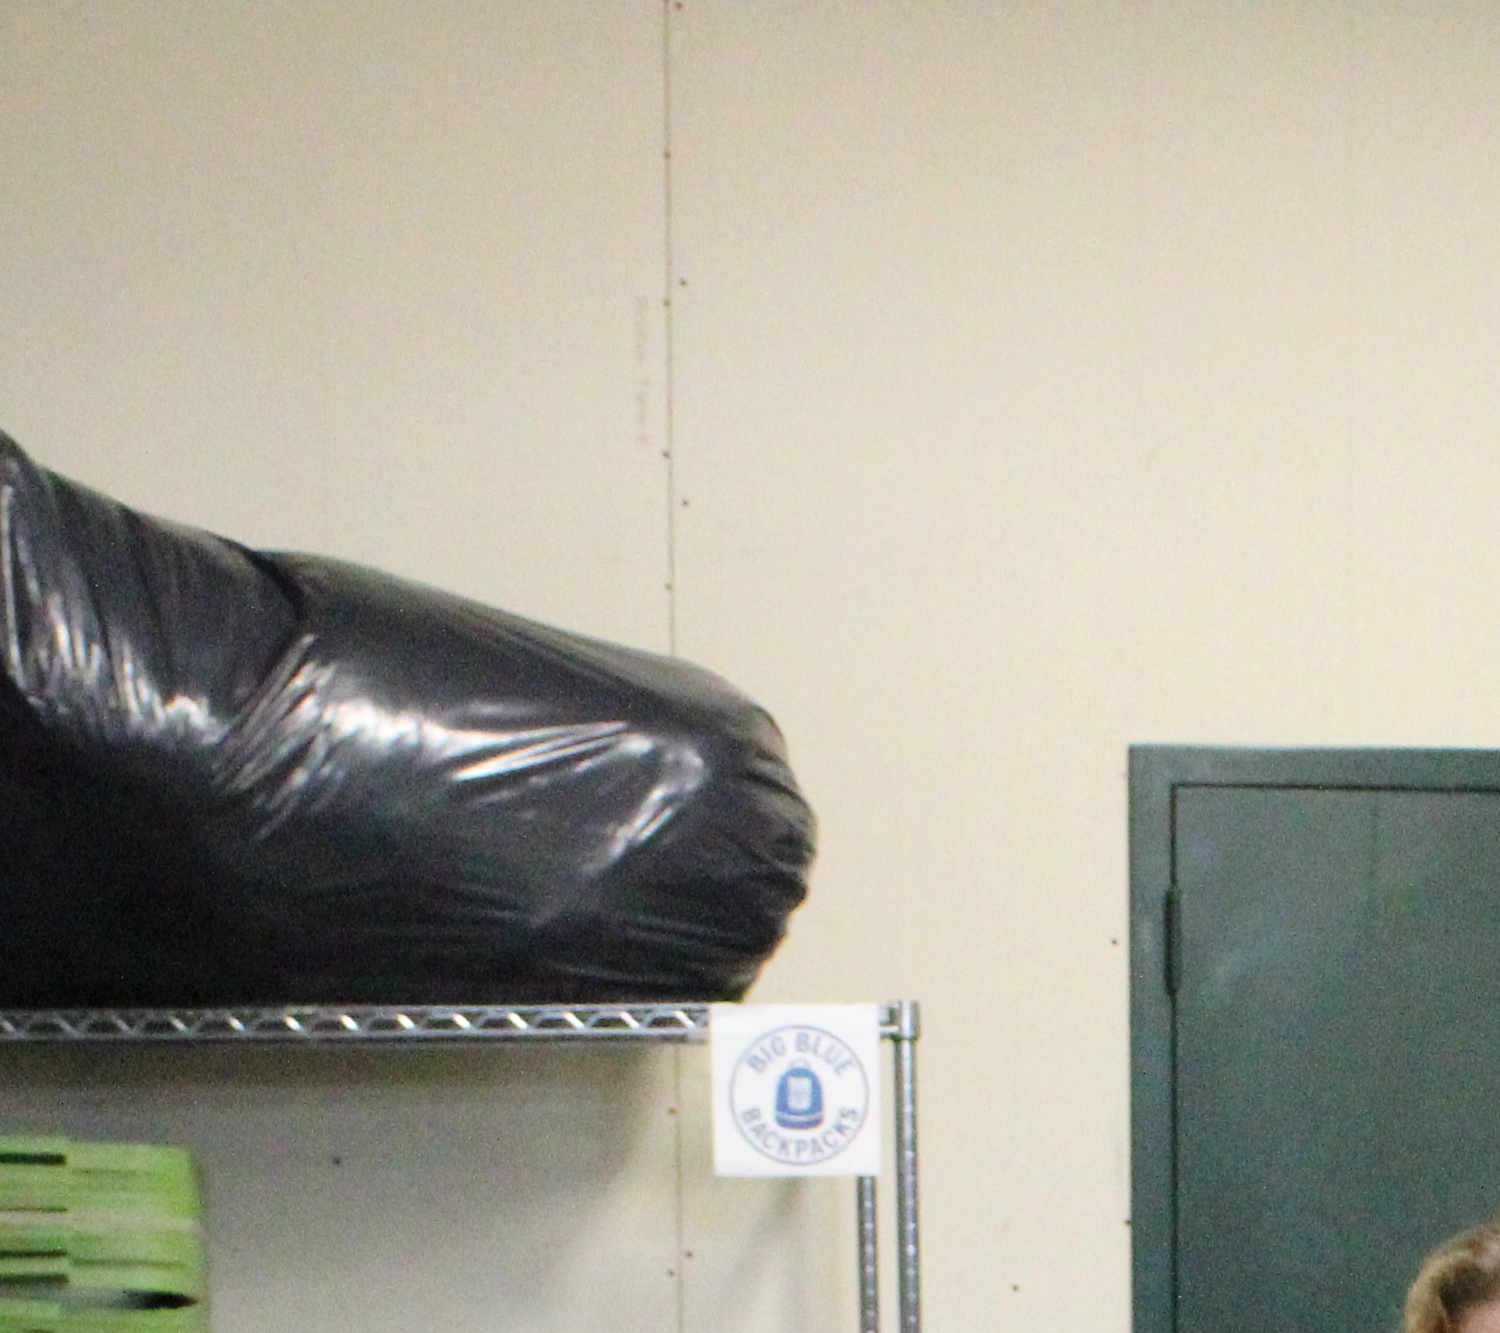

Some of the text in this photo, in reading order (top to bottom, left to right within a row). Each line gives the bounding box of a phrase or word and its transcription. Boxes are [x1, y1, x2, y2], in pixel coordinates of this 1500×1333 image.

[746, 1030, 856, 1078] BIG BLUE
[740, 1104, 860, 1160] BACKPACKS
